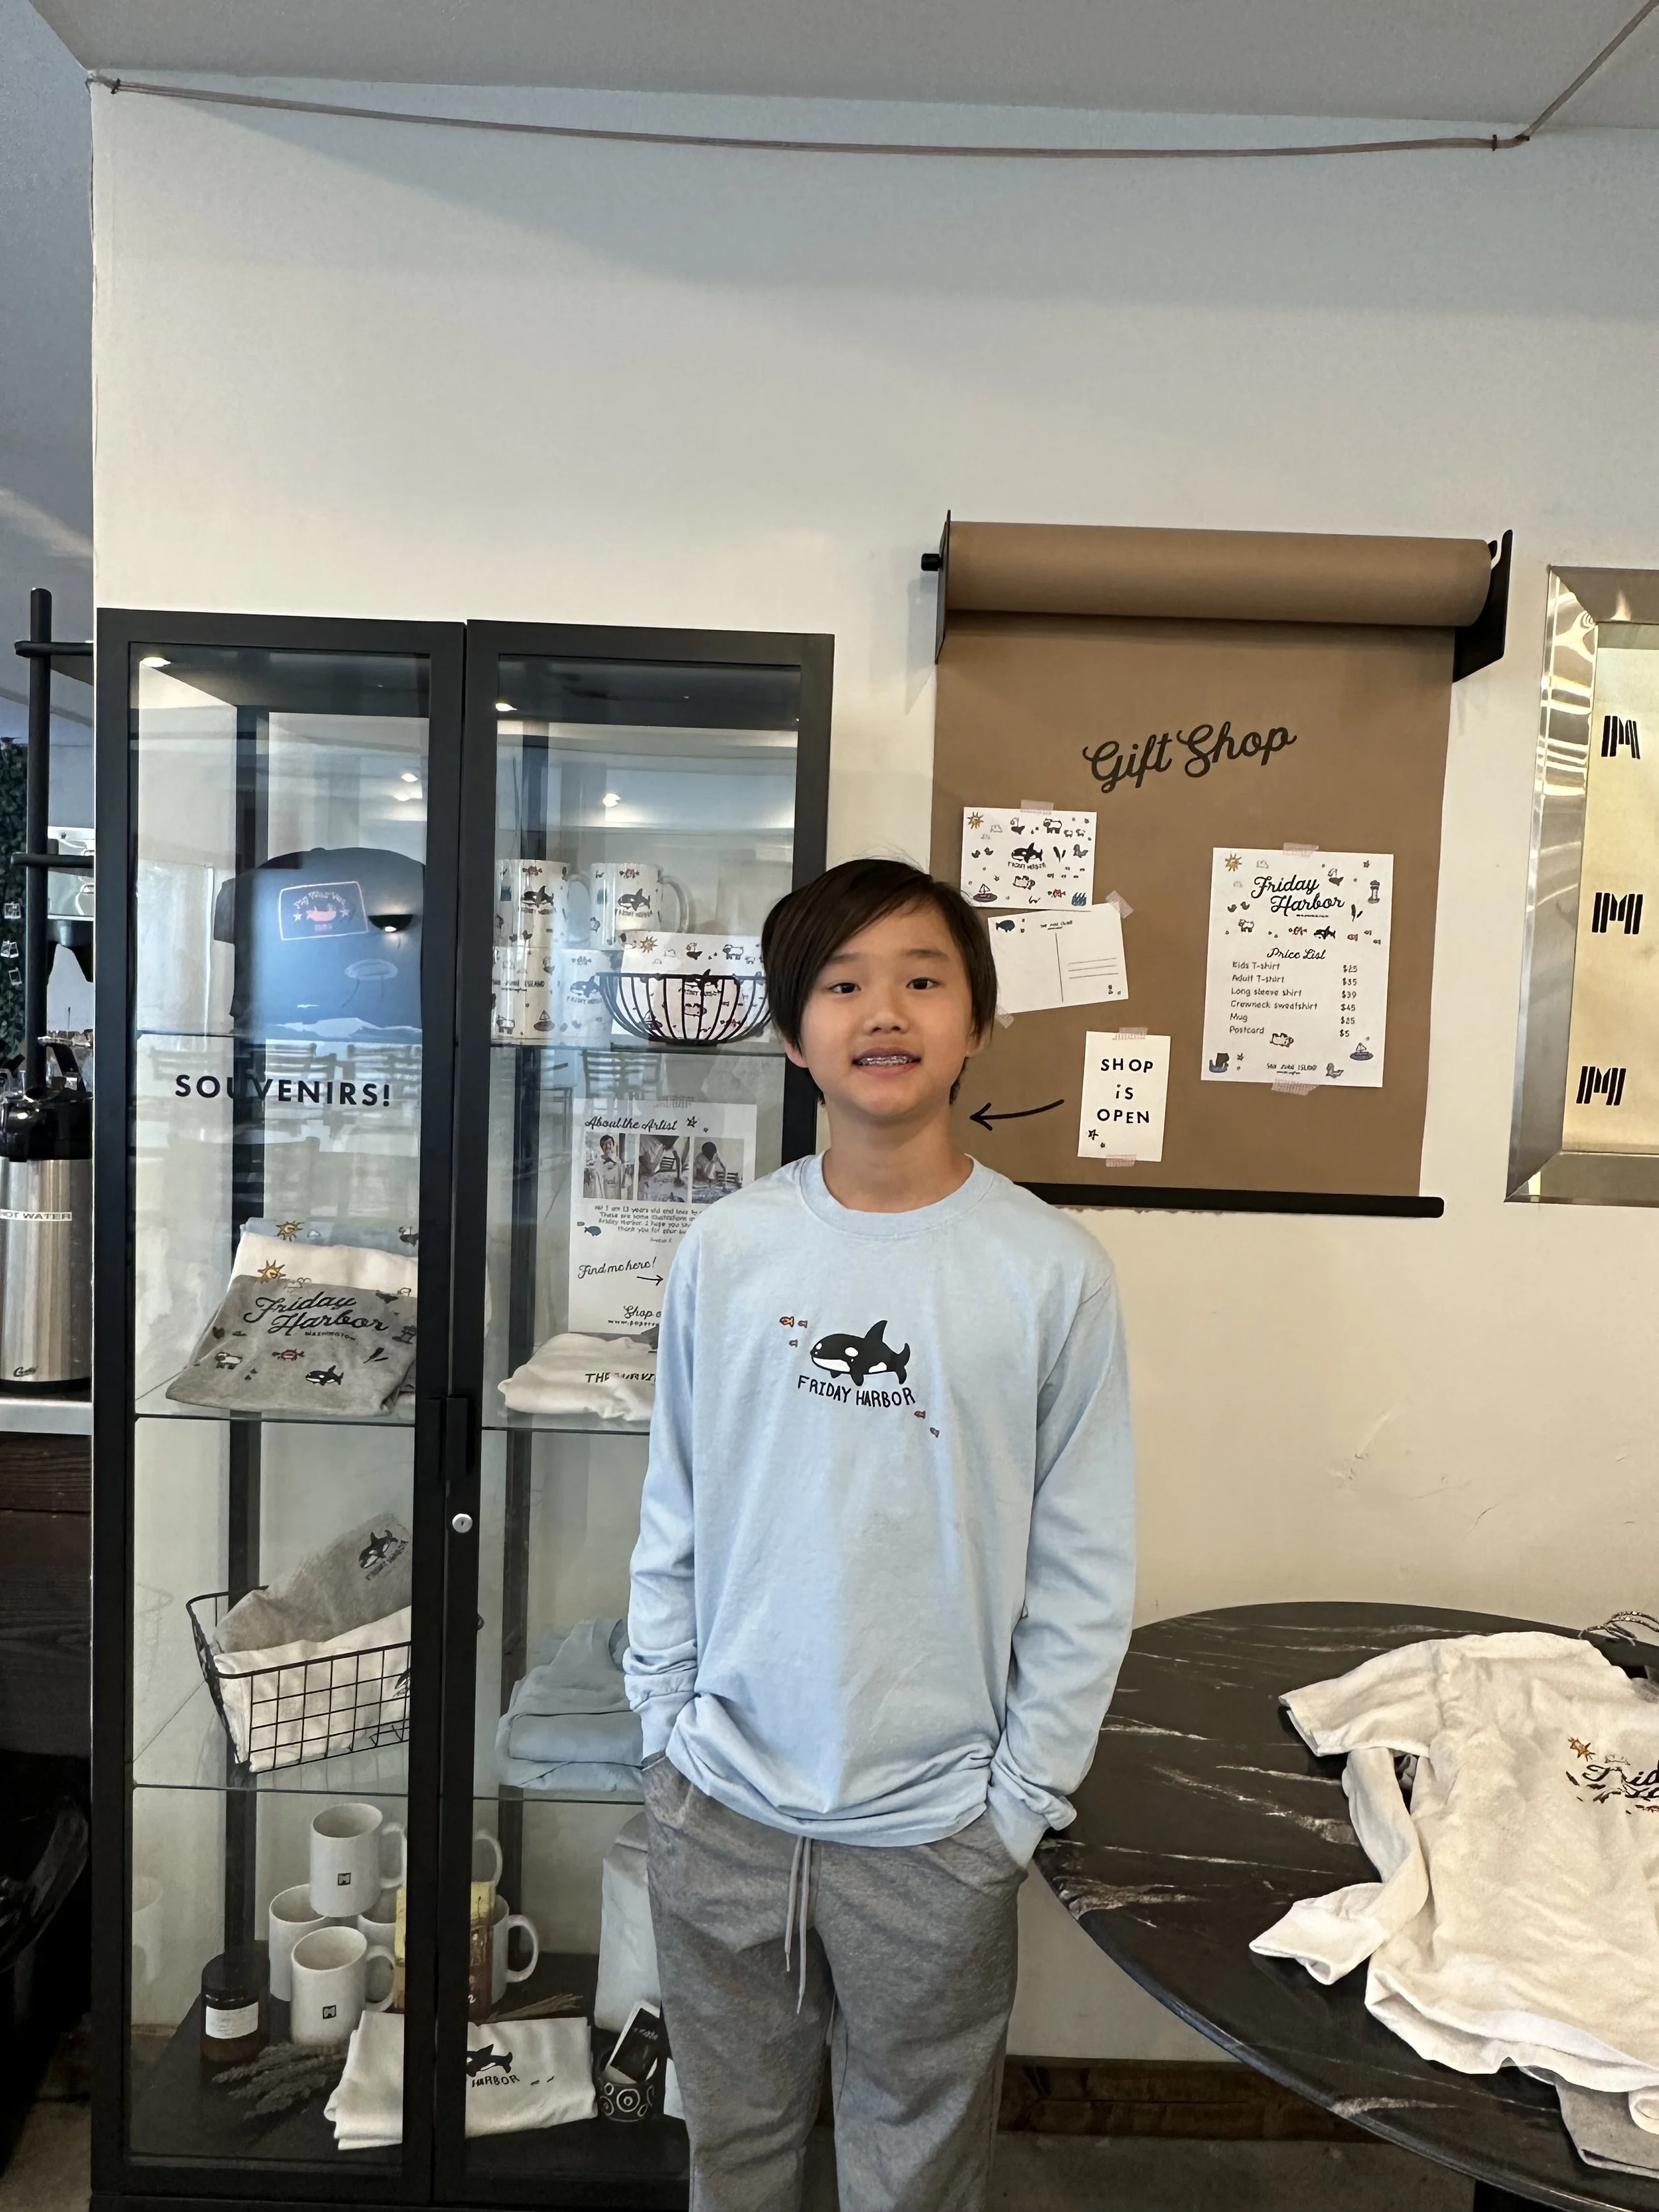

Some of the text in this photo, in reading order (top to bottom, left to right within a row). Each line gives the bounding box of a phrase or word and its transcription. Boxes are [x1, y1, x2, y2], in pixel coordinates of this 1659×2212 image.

[1083, 721, 1297, 793] Gift Shop
[1251, 875, 1319, 899] Friday
[1270, 893, 1345, 916] Harbor
[1267, 948, 1326, 960] Price List
[1252, 962, 1280, 970] T-shirt
[1342, 964, 1358, 973] $25
[1232, 974, 1284, 984] Adult T-shirt
[1342, 978, 1357, 986] $35
[1231, 988, 1251, 996] Long
[1342, 990, 1357, 999] $39
[1230, 1013, 1248, 1022] Mug
[1340, 1016, 1355, 1025] $25
[1229, 1025, 1265, 1034] Postcard
[1100, 1058, 1153, 1073] SHOP
[175, 1074, 390, 1107] SOUVENIRS!
[1097, 1108, 1150, 1124] OPEN
[585, 1116, 678, 1132] About the Artist
[578, 1263, 607, 1279] Find
[244, 1291, 356, 1323] Friday
[624, 1305, 654, 1319] Shop
[268, 1309, 389, 1336] Harbor
[585, 1372, 611, 1383] THE
[798, 1374, 916, 1408] FRIDAY HARBOR
[472, 2075, 520, 2088] HARBOR
